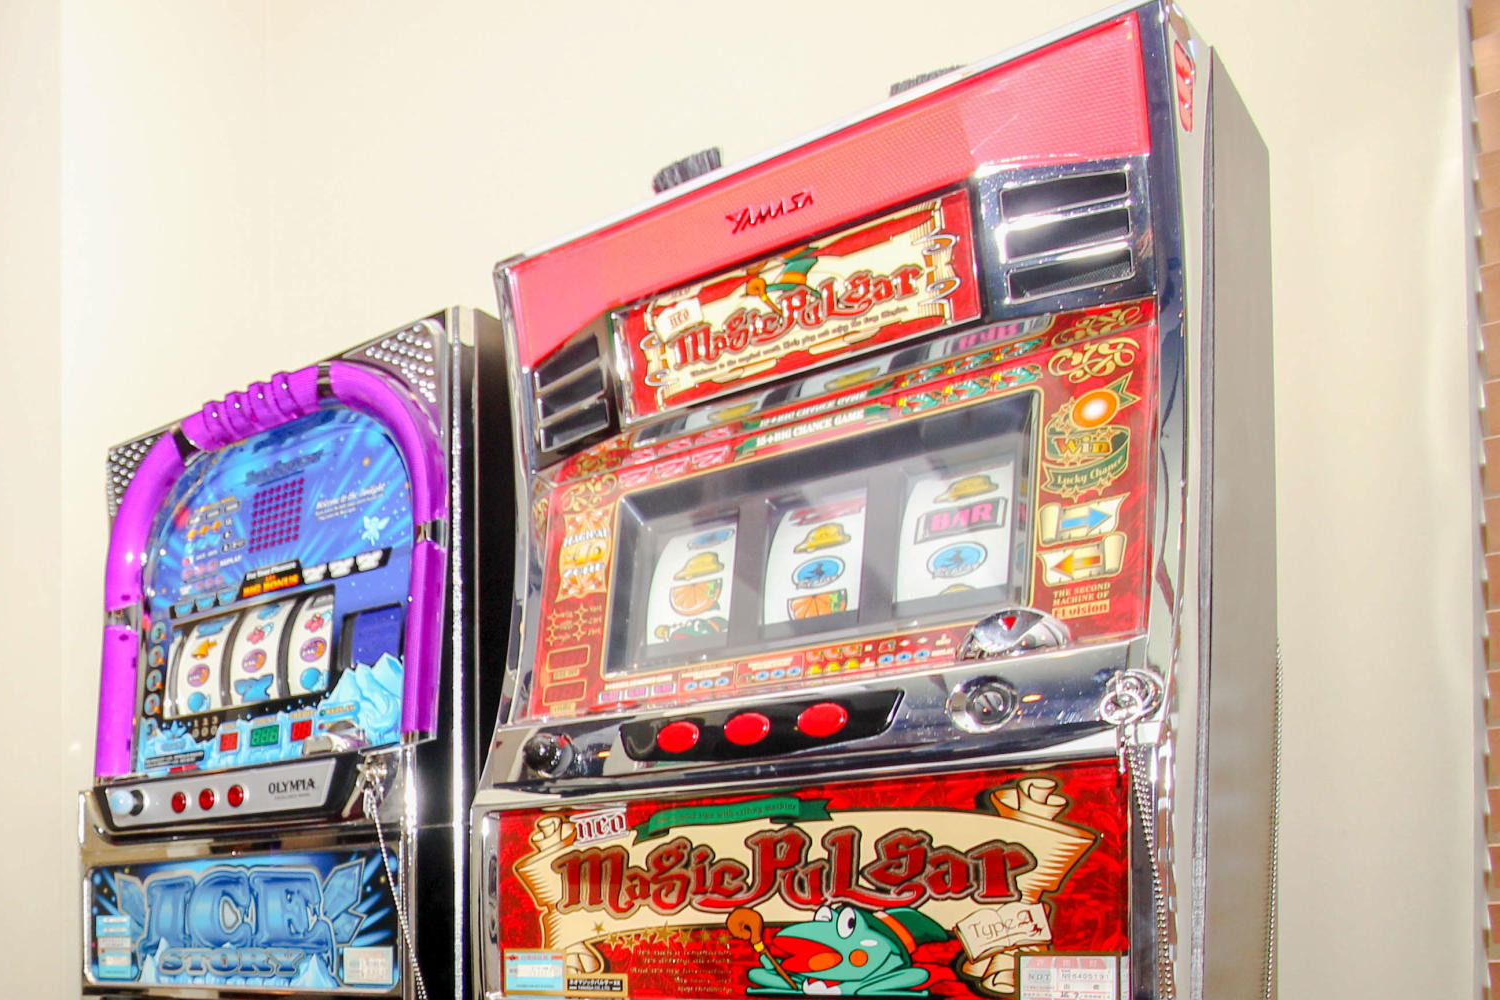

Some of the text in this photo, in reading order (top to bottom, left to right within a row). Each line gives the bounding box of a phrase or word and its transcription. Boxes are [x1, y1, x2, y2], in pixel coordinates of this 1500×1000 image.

[930, 504, 994, 533] BAR
[141, 867, 334, 951] ICE
[160, 948, 304, 977] STORY
